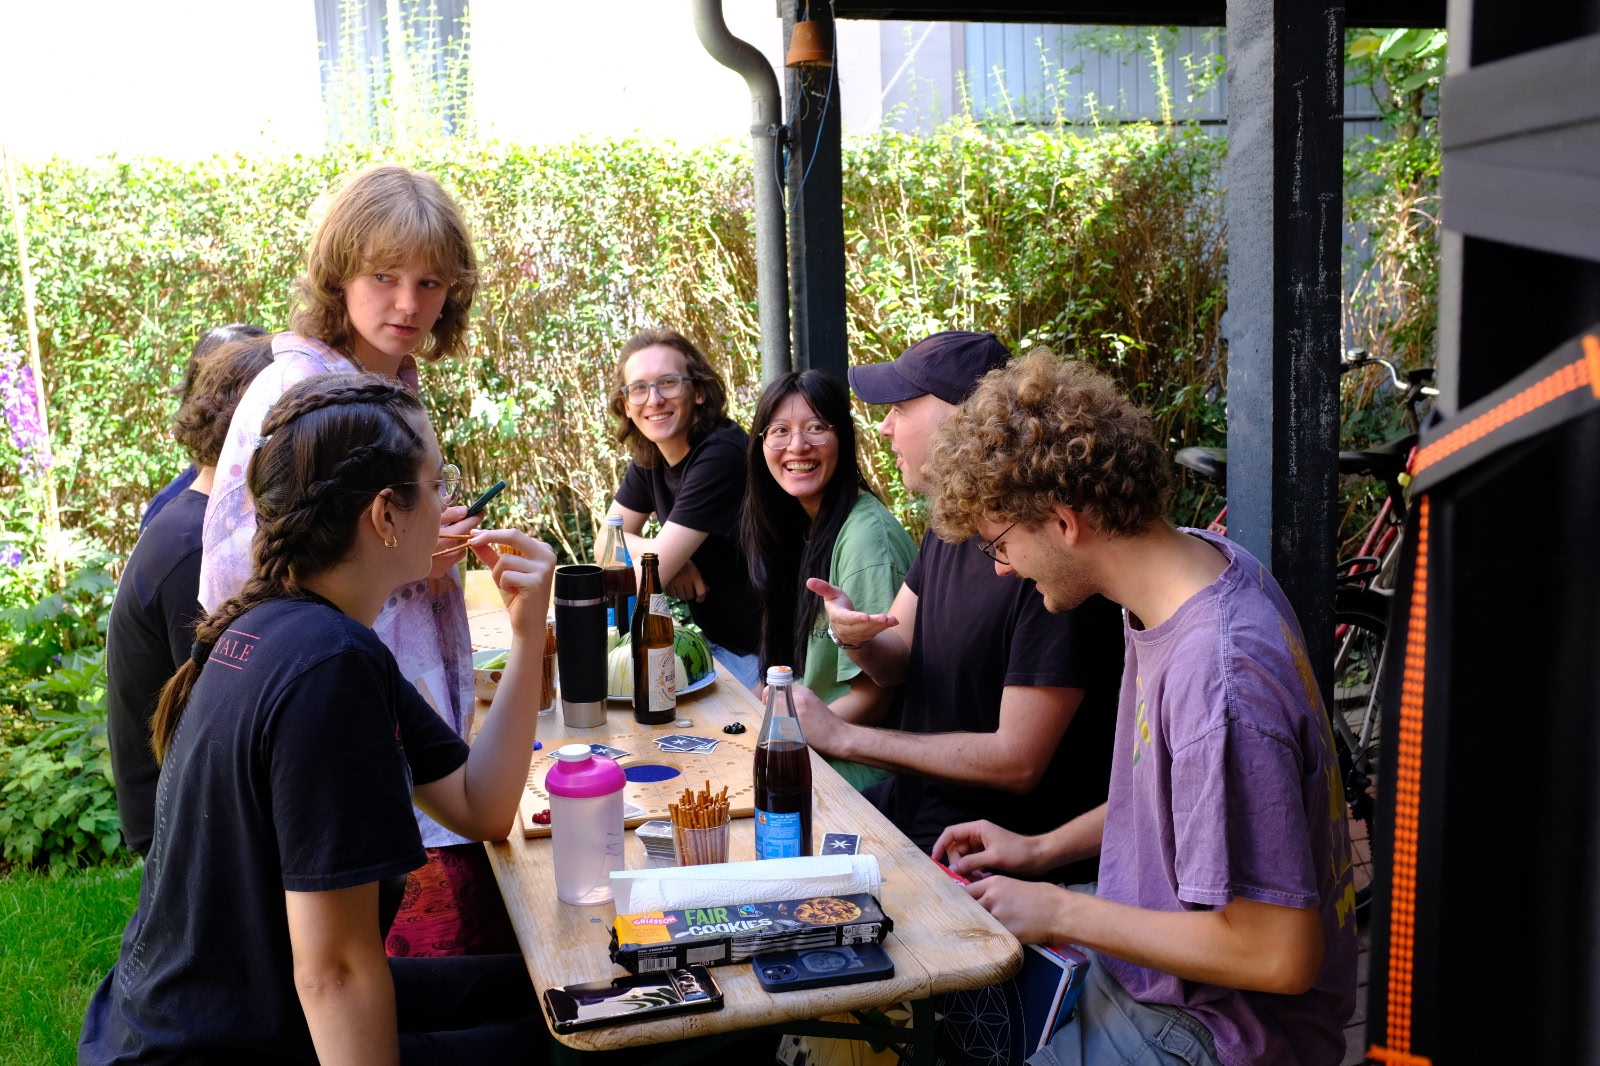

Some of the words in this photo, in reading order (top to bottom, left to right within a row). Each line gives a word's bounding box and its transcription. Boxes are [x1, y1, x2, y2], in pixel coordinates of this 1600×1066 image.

[215, 638, 254, 661] YALE
[633, 916, 676, 925] GRIESSON
[684, 907, 730, 926] FAIR
[688, 918, 773, 936] COOKIES
